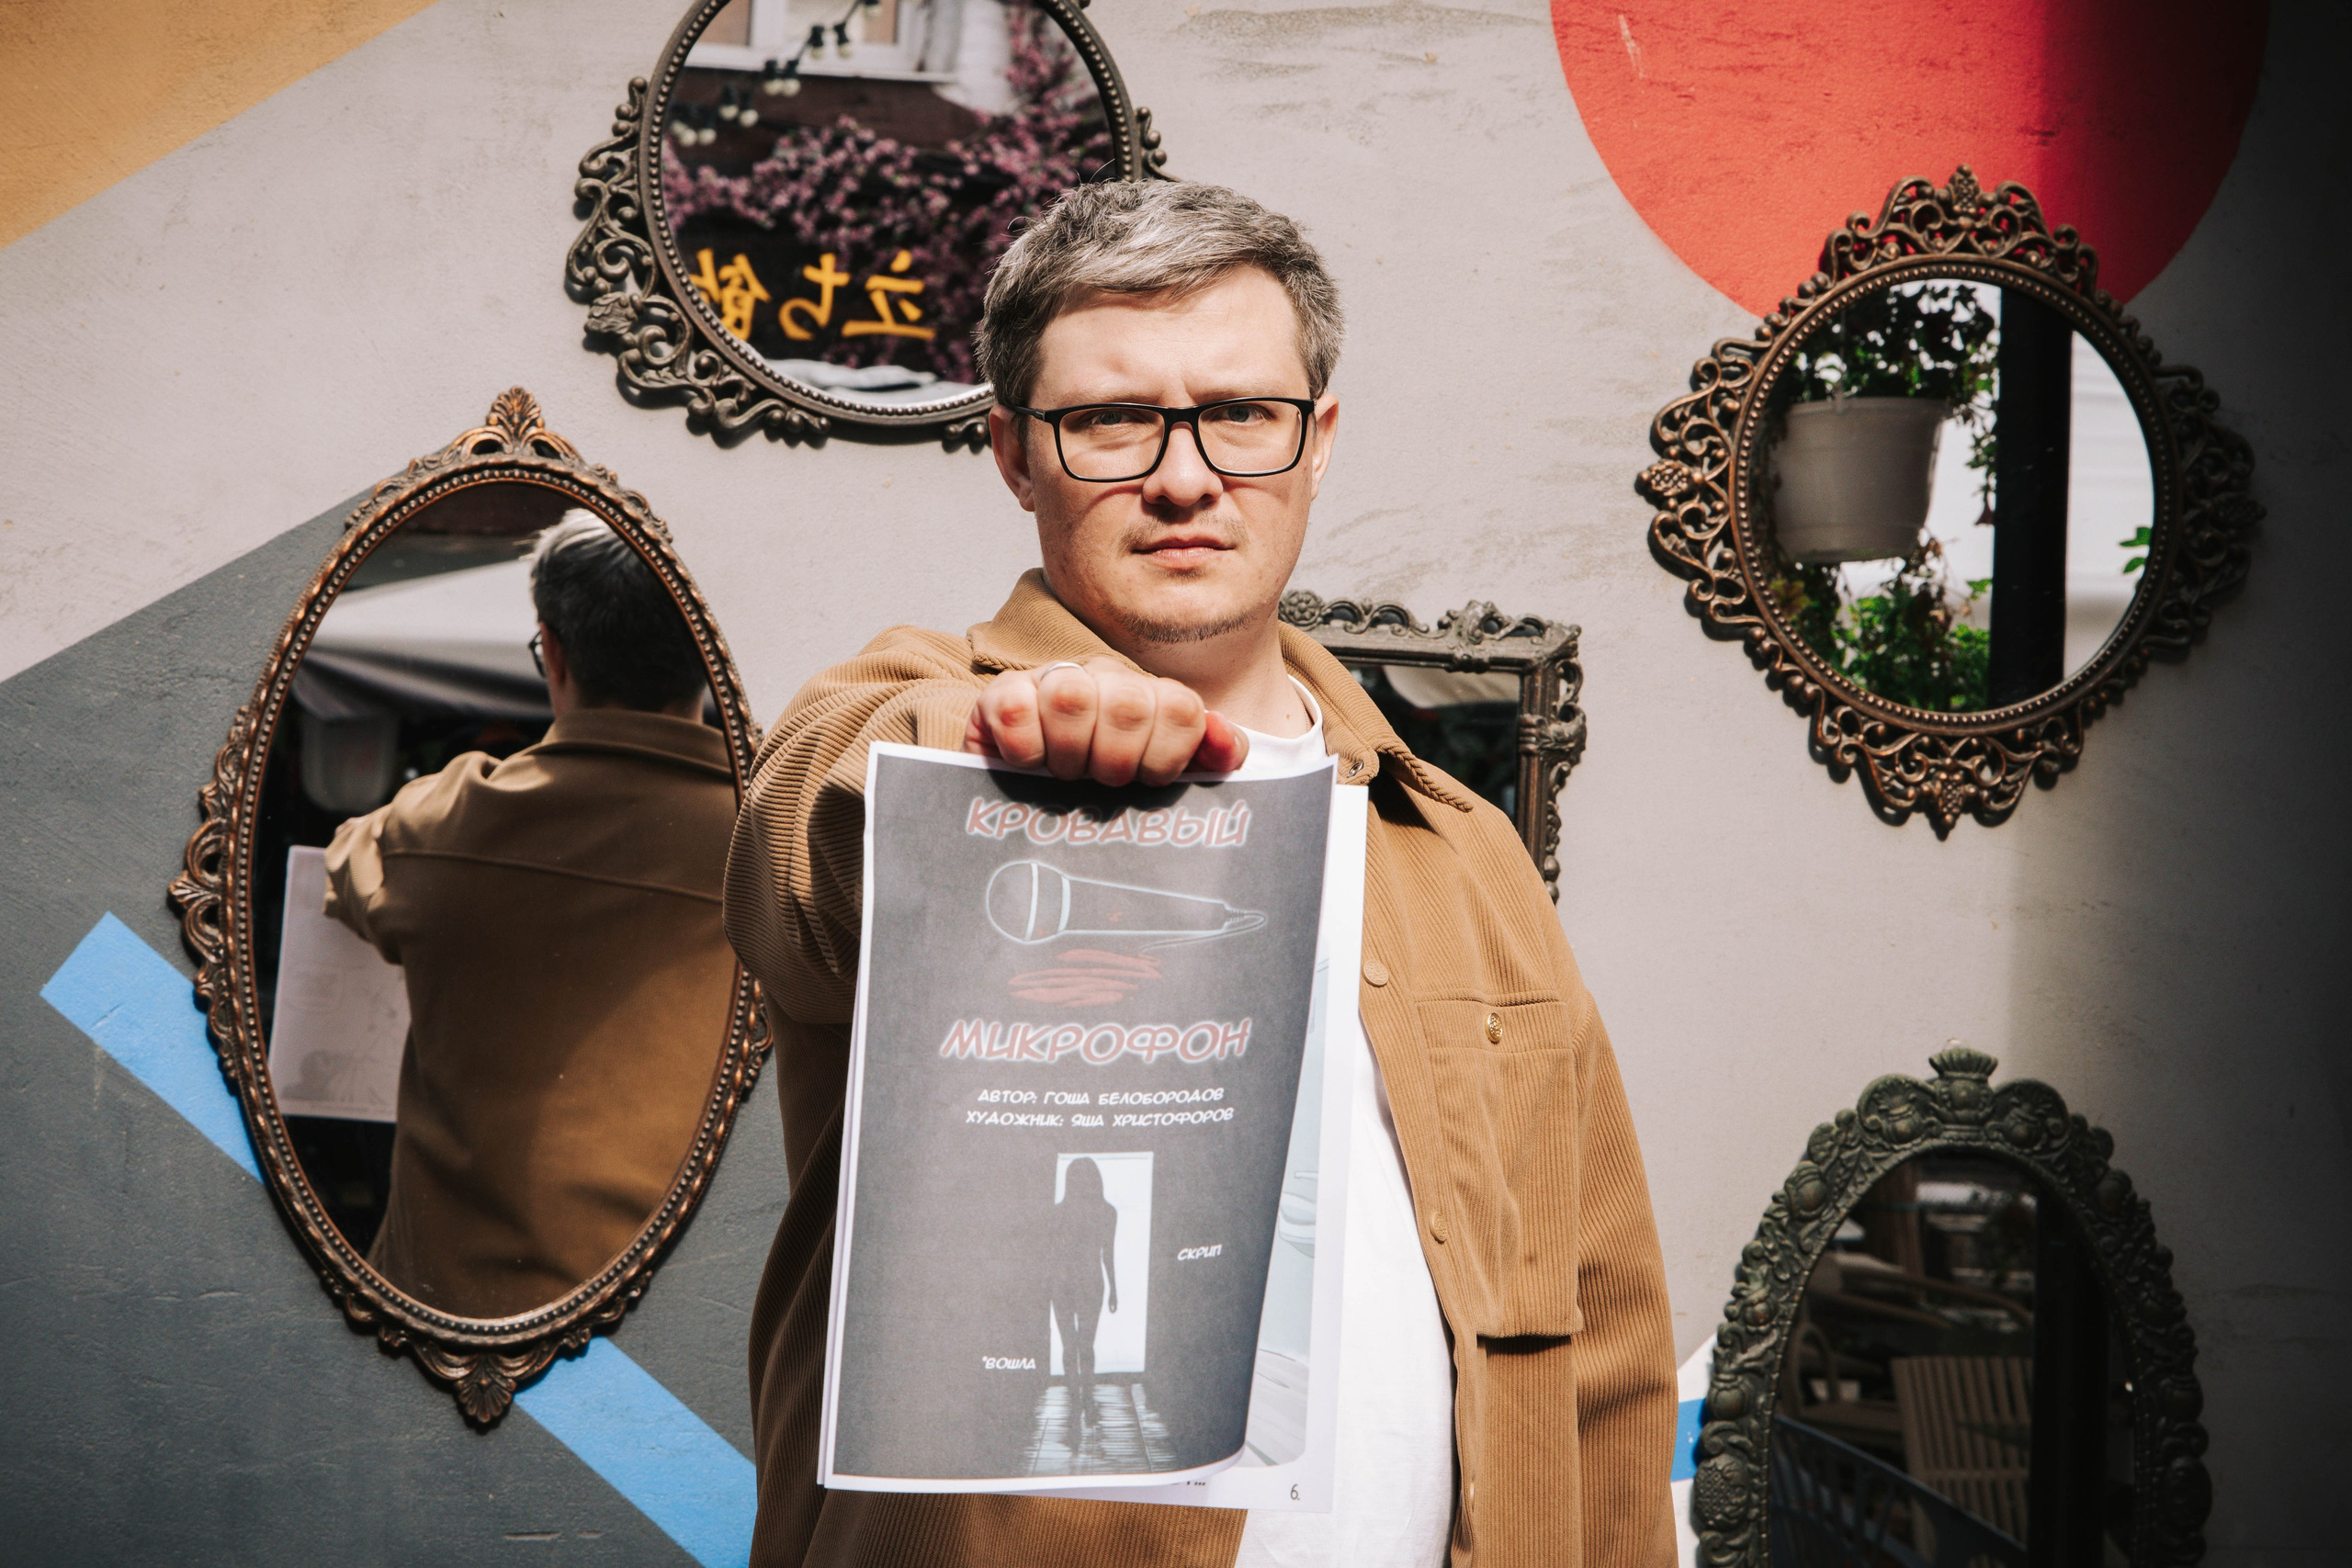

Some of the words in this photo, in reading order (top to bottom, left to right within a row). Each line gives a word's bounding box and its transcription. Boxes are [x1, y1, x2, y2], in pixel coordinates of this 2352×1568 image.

[965, 797, 1253, 849] КРОВАВЫЙ
[939, 1018, 1253, 1065] МИКРОФОН
[977, 1089, 1038, 1104] АВТОР:
[1044, 1091, 1091, 1105] ГОША
[1098, 1087, 1225, 1106] БЕЛОБОРОДОВ
[966, 1110, 1065, 1128] ХУДОЖНИК:
[1070, 1113, 1104, 1127] ЯША
[1112, 1107, 1235, 1128] ХРИСТОФОРОВ
[1177, 1244, 1223, 1261] СКРИП
